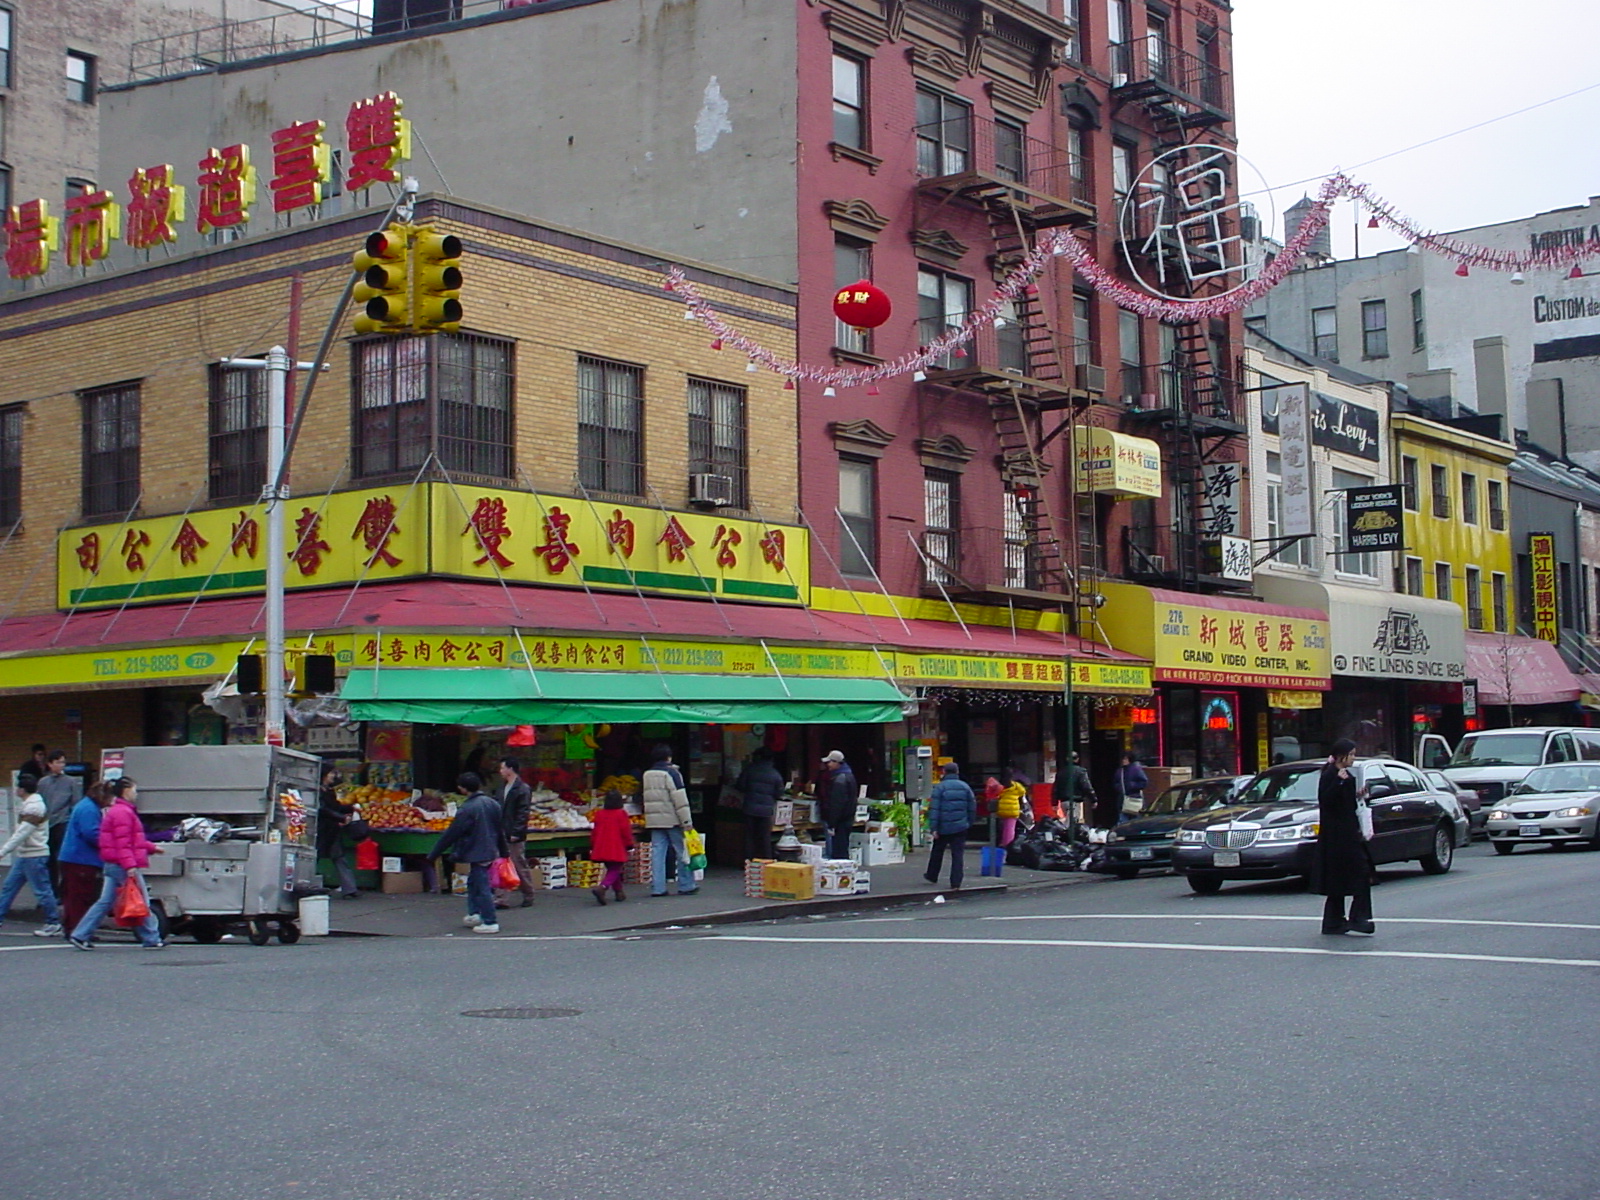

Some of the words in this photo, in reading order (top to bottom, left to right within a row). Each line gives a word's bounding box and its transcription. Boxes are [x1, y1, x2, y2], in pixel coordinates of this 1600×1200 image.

[1534, 295, 1585, 323] CUSTOM
[1331, 403, 1367, 452] Levy
[1352, 534, 1378, 546] HARRIS
[1379, 533, 1398, 545] LEVY
[1168, 609, 1183, 624] 276
[1162, 624, 1180, 635] GRAND
[1199, 614, 1295, 652] 新城電器
[94, 658, 121, 675] TEL:
[1183, 650, 1213, 663] GRAND
[1221, 653, 1246, 667] VIDEO
[1255, 656, 1288, 671] CENTER,
[1296, 659, 1311, 671] INC.
[1352, 656, 1375, 672] FINE
[1380, 658, 1414, 674] LINENS
[1417, 661, 1443, 677] SINCE
[903, 665, 916, 676] 274
